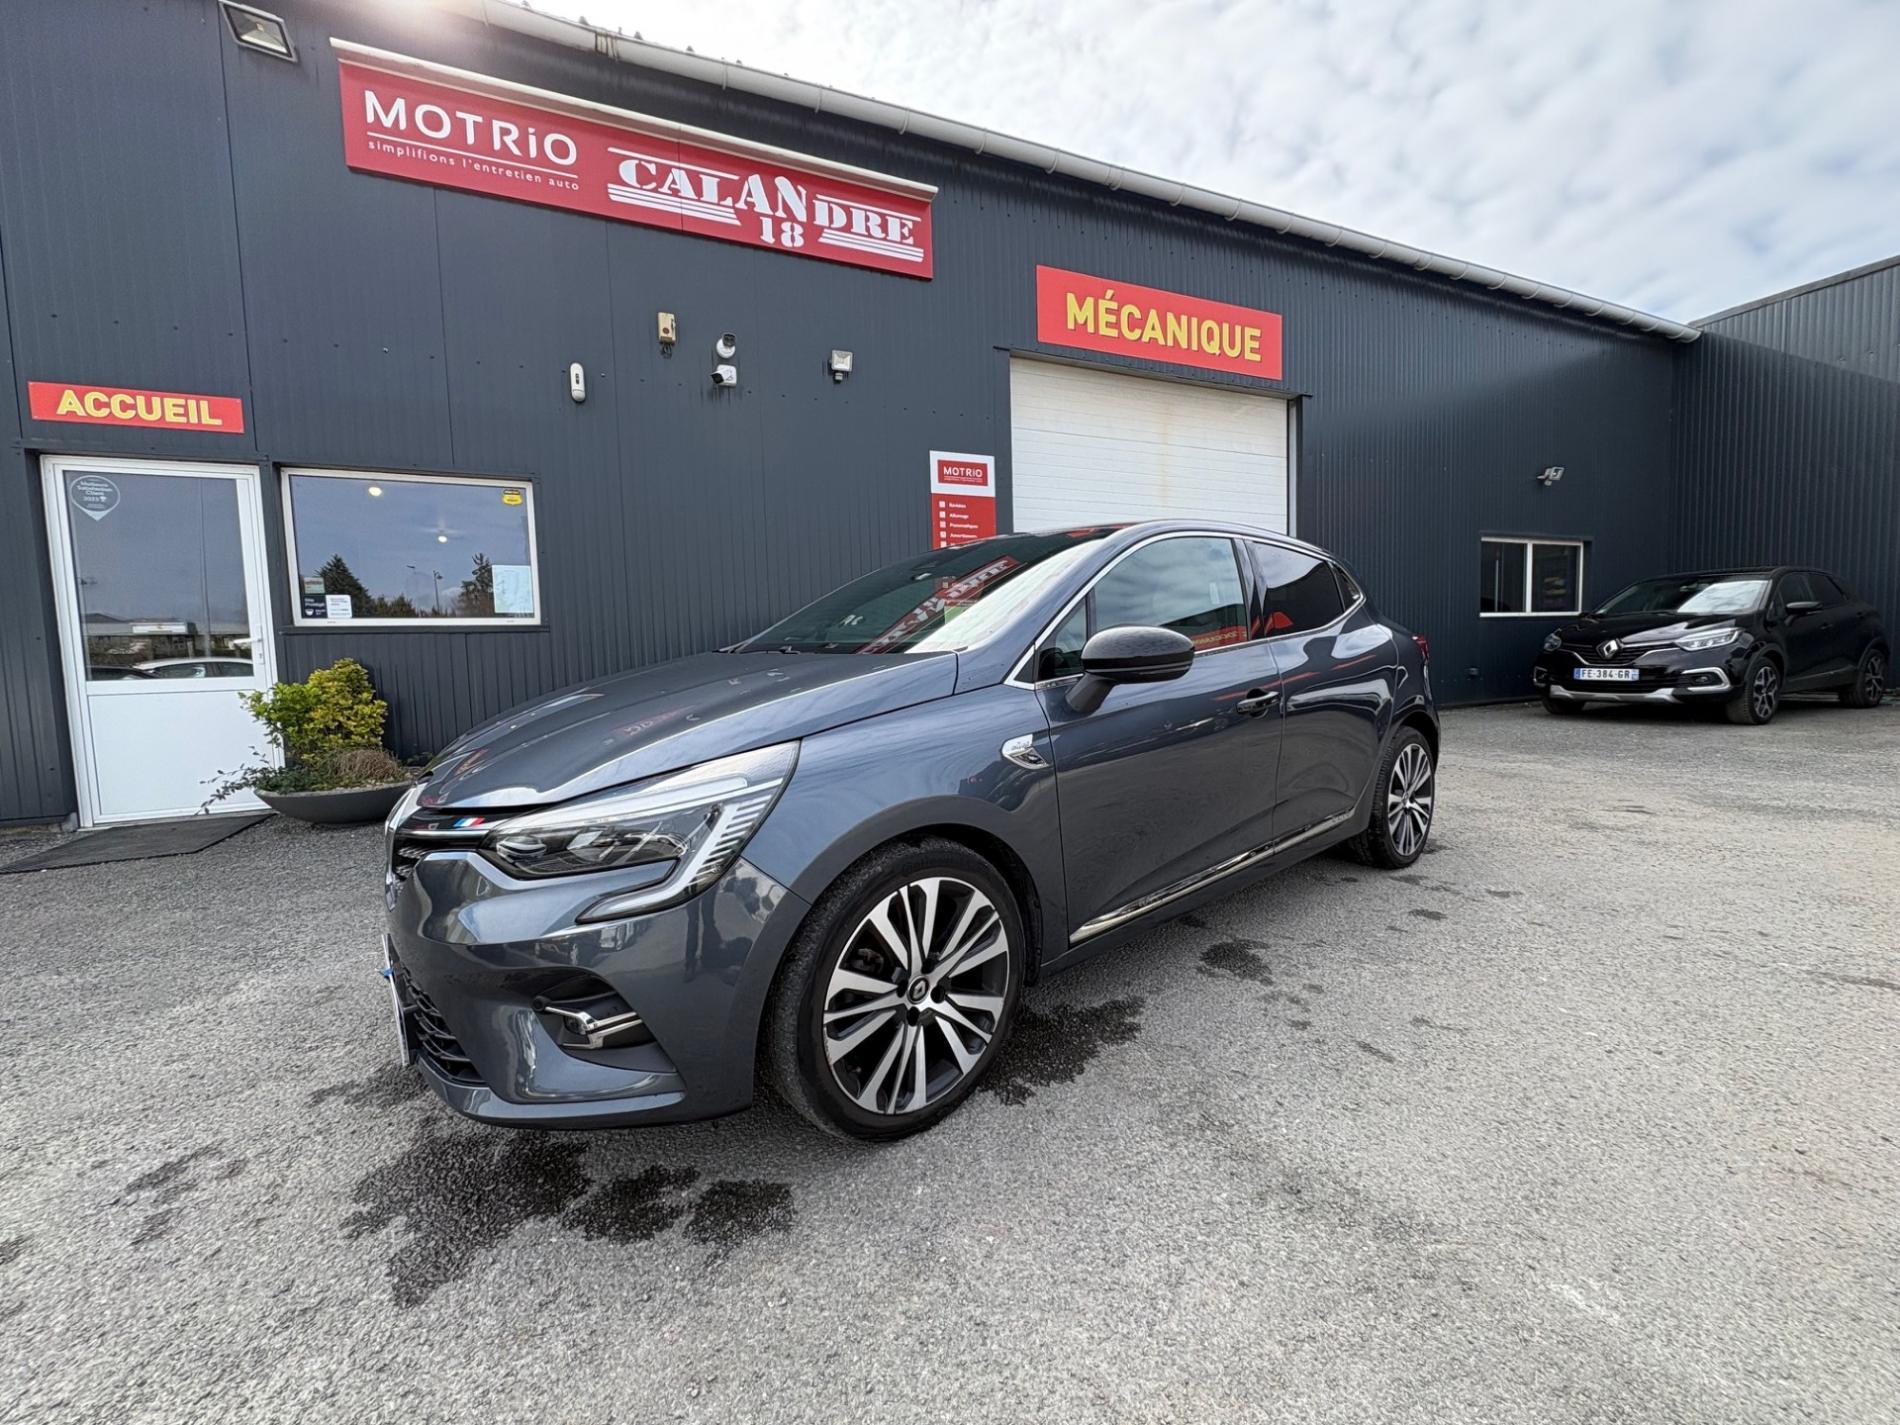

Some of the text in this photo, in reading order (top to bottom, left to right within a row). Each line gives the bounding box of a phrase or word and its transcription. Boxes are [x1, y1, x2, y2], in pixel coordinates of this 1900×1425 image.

[368, 140, 580, 192] simplifions l'entretien auto
[618, 158, 914, 245] CALANDRE
[759, 216, 805, 248] 18
[1066, 289, 1262, 362] MÉCANIQUE
[56, 389, 223, 426] ACCUEIL
